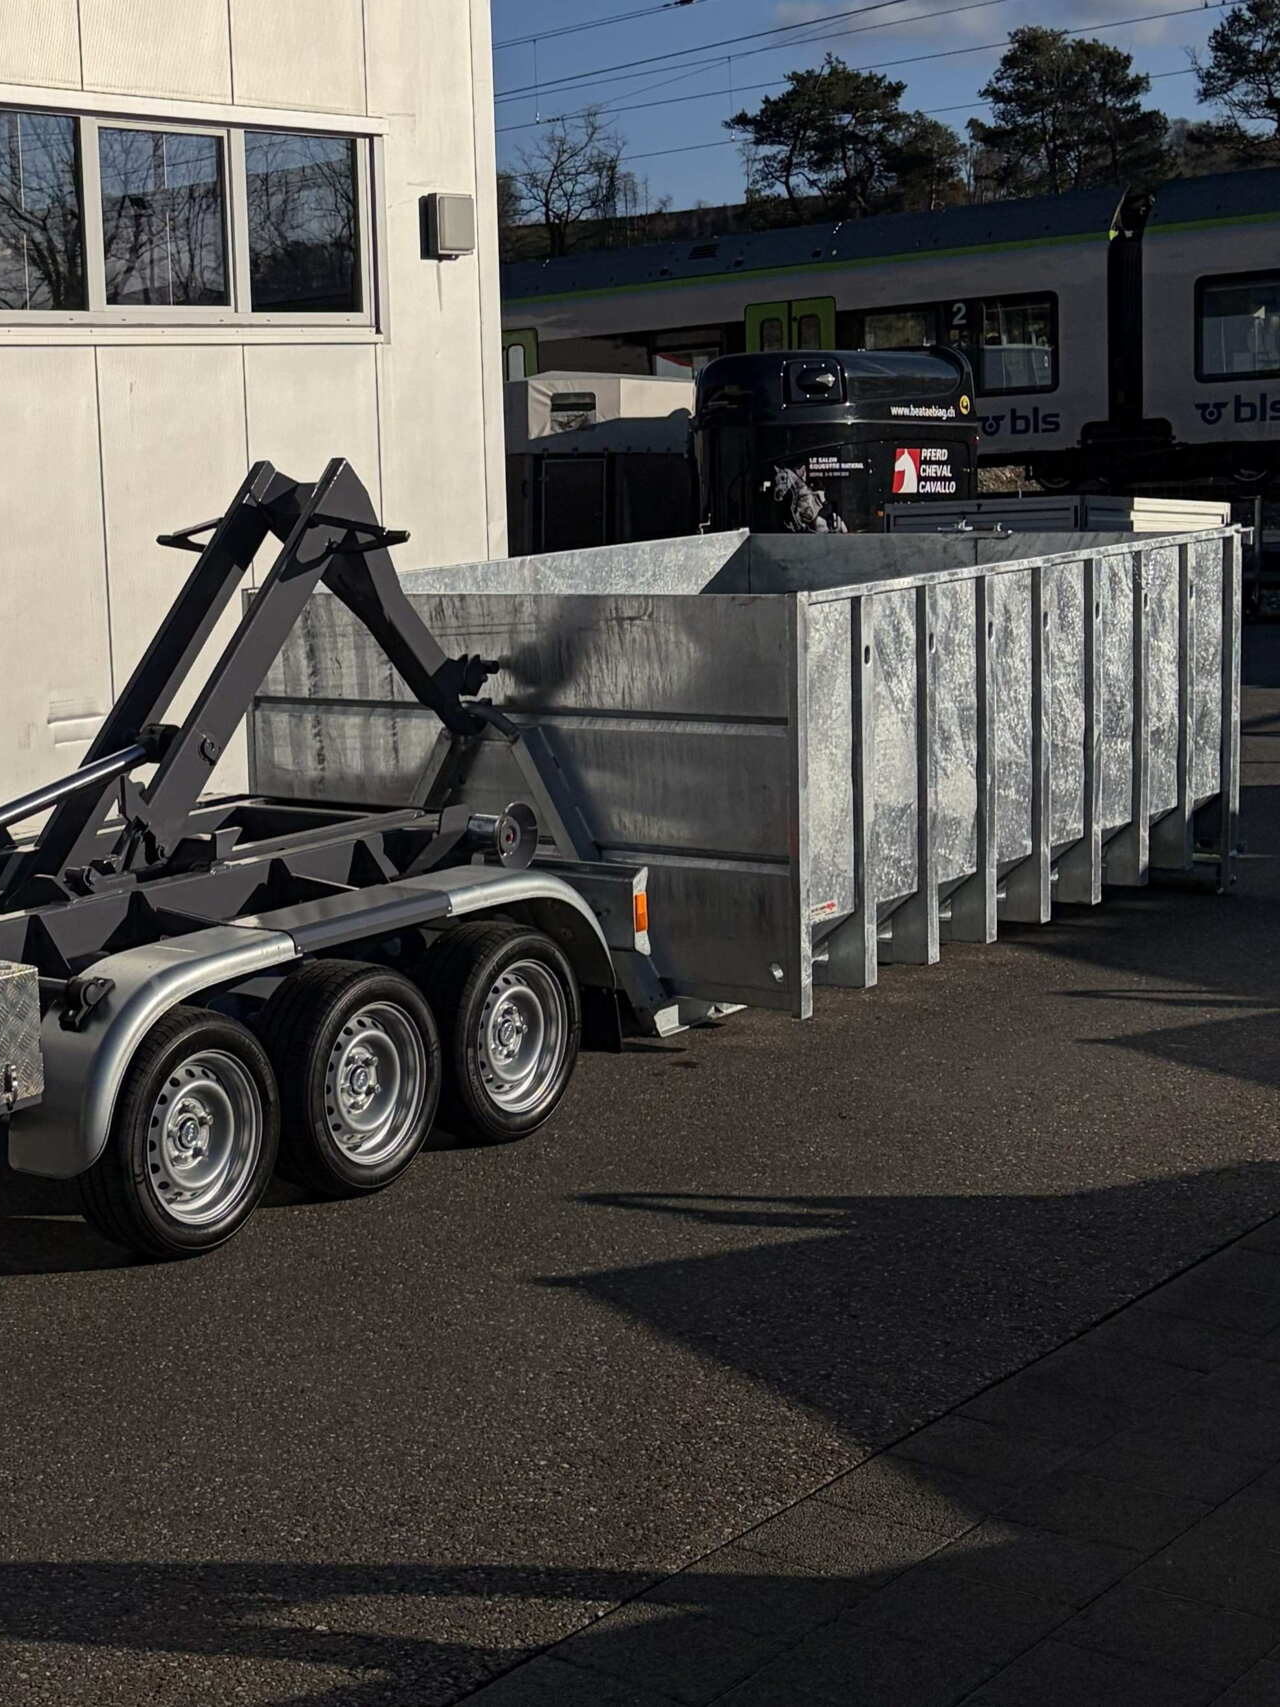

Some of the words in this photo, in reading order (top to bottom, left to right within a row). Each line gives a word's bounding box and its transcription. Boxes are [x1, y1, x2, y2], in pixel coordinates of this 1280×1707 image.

[952, 302, 967, 325] 2
[890, 404, 956, 420] www.beataebiag.ch
[1010, 406, 1060, 435] bls
[921, 449, 948, 461] PFERD
[920, 464, 952, 477] CHEVAL
[919, 481, 956, 494] CAVALLO
